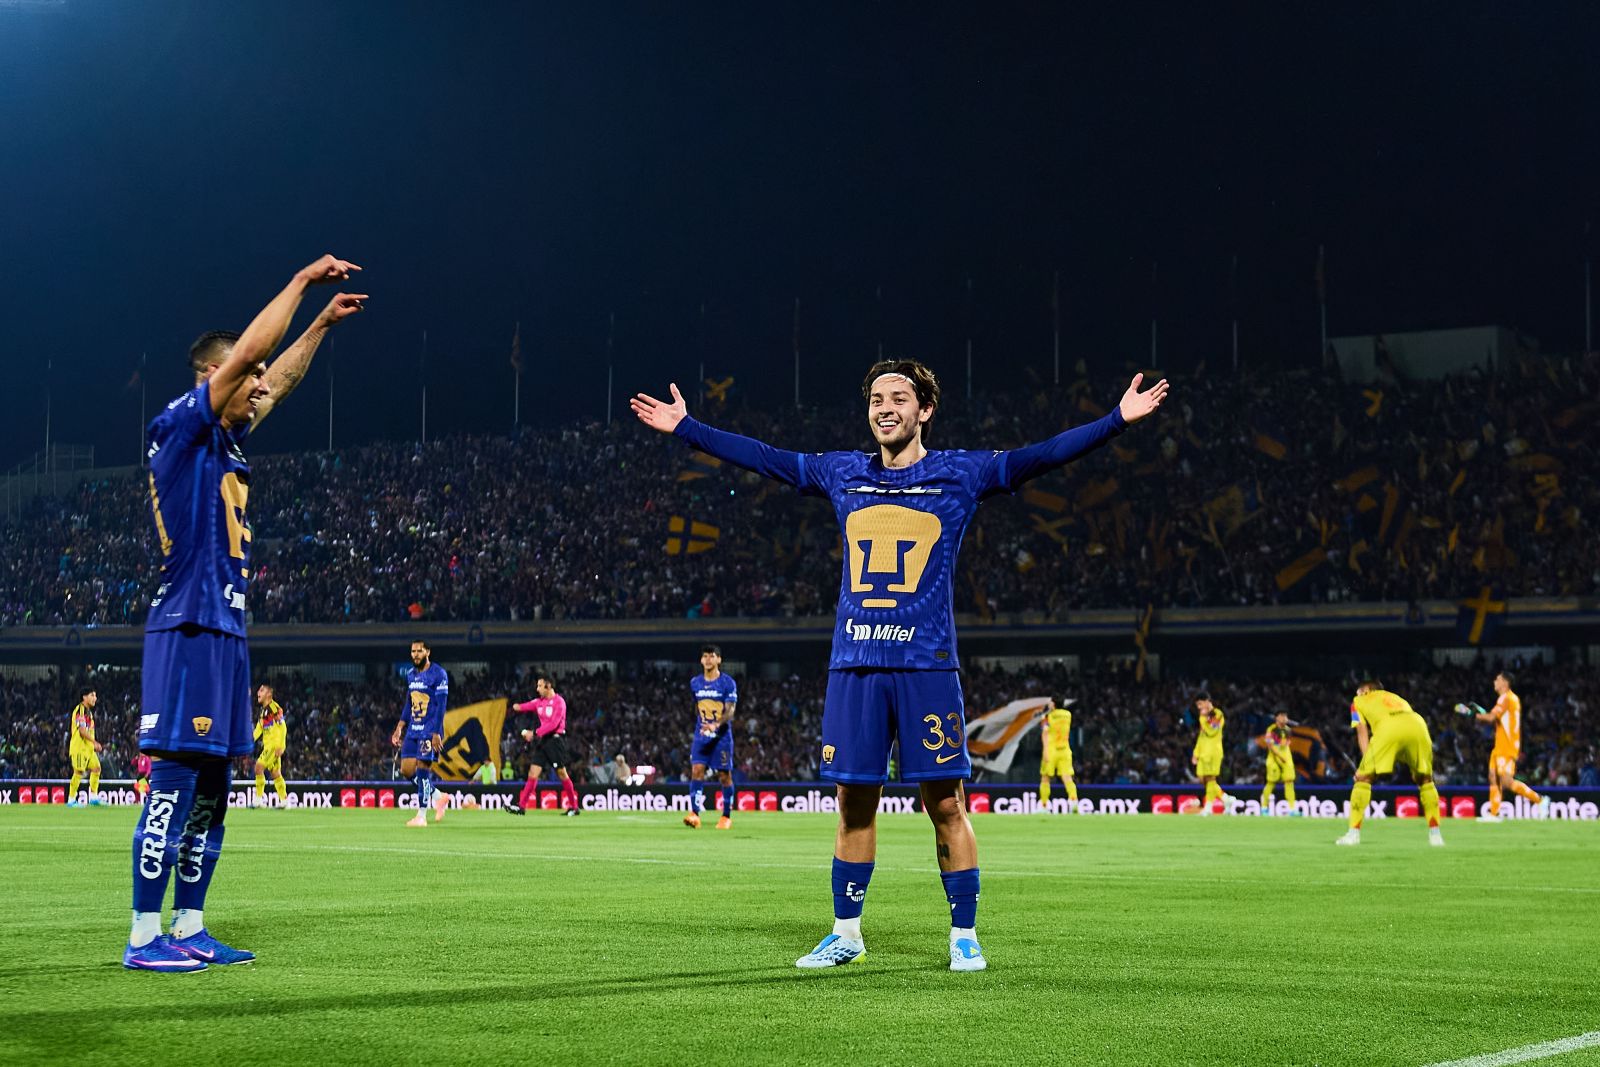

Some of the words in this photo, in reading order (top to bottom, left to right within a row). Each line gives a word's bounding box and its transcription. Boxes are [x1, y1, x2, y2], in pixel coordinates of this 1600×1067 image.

[872, 624, 916, 642] Mifel
[922, 712, 964, 750] 33
[139, 789, 179, 880] CREST
